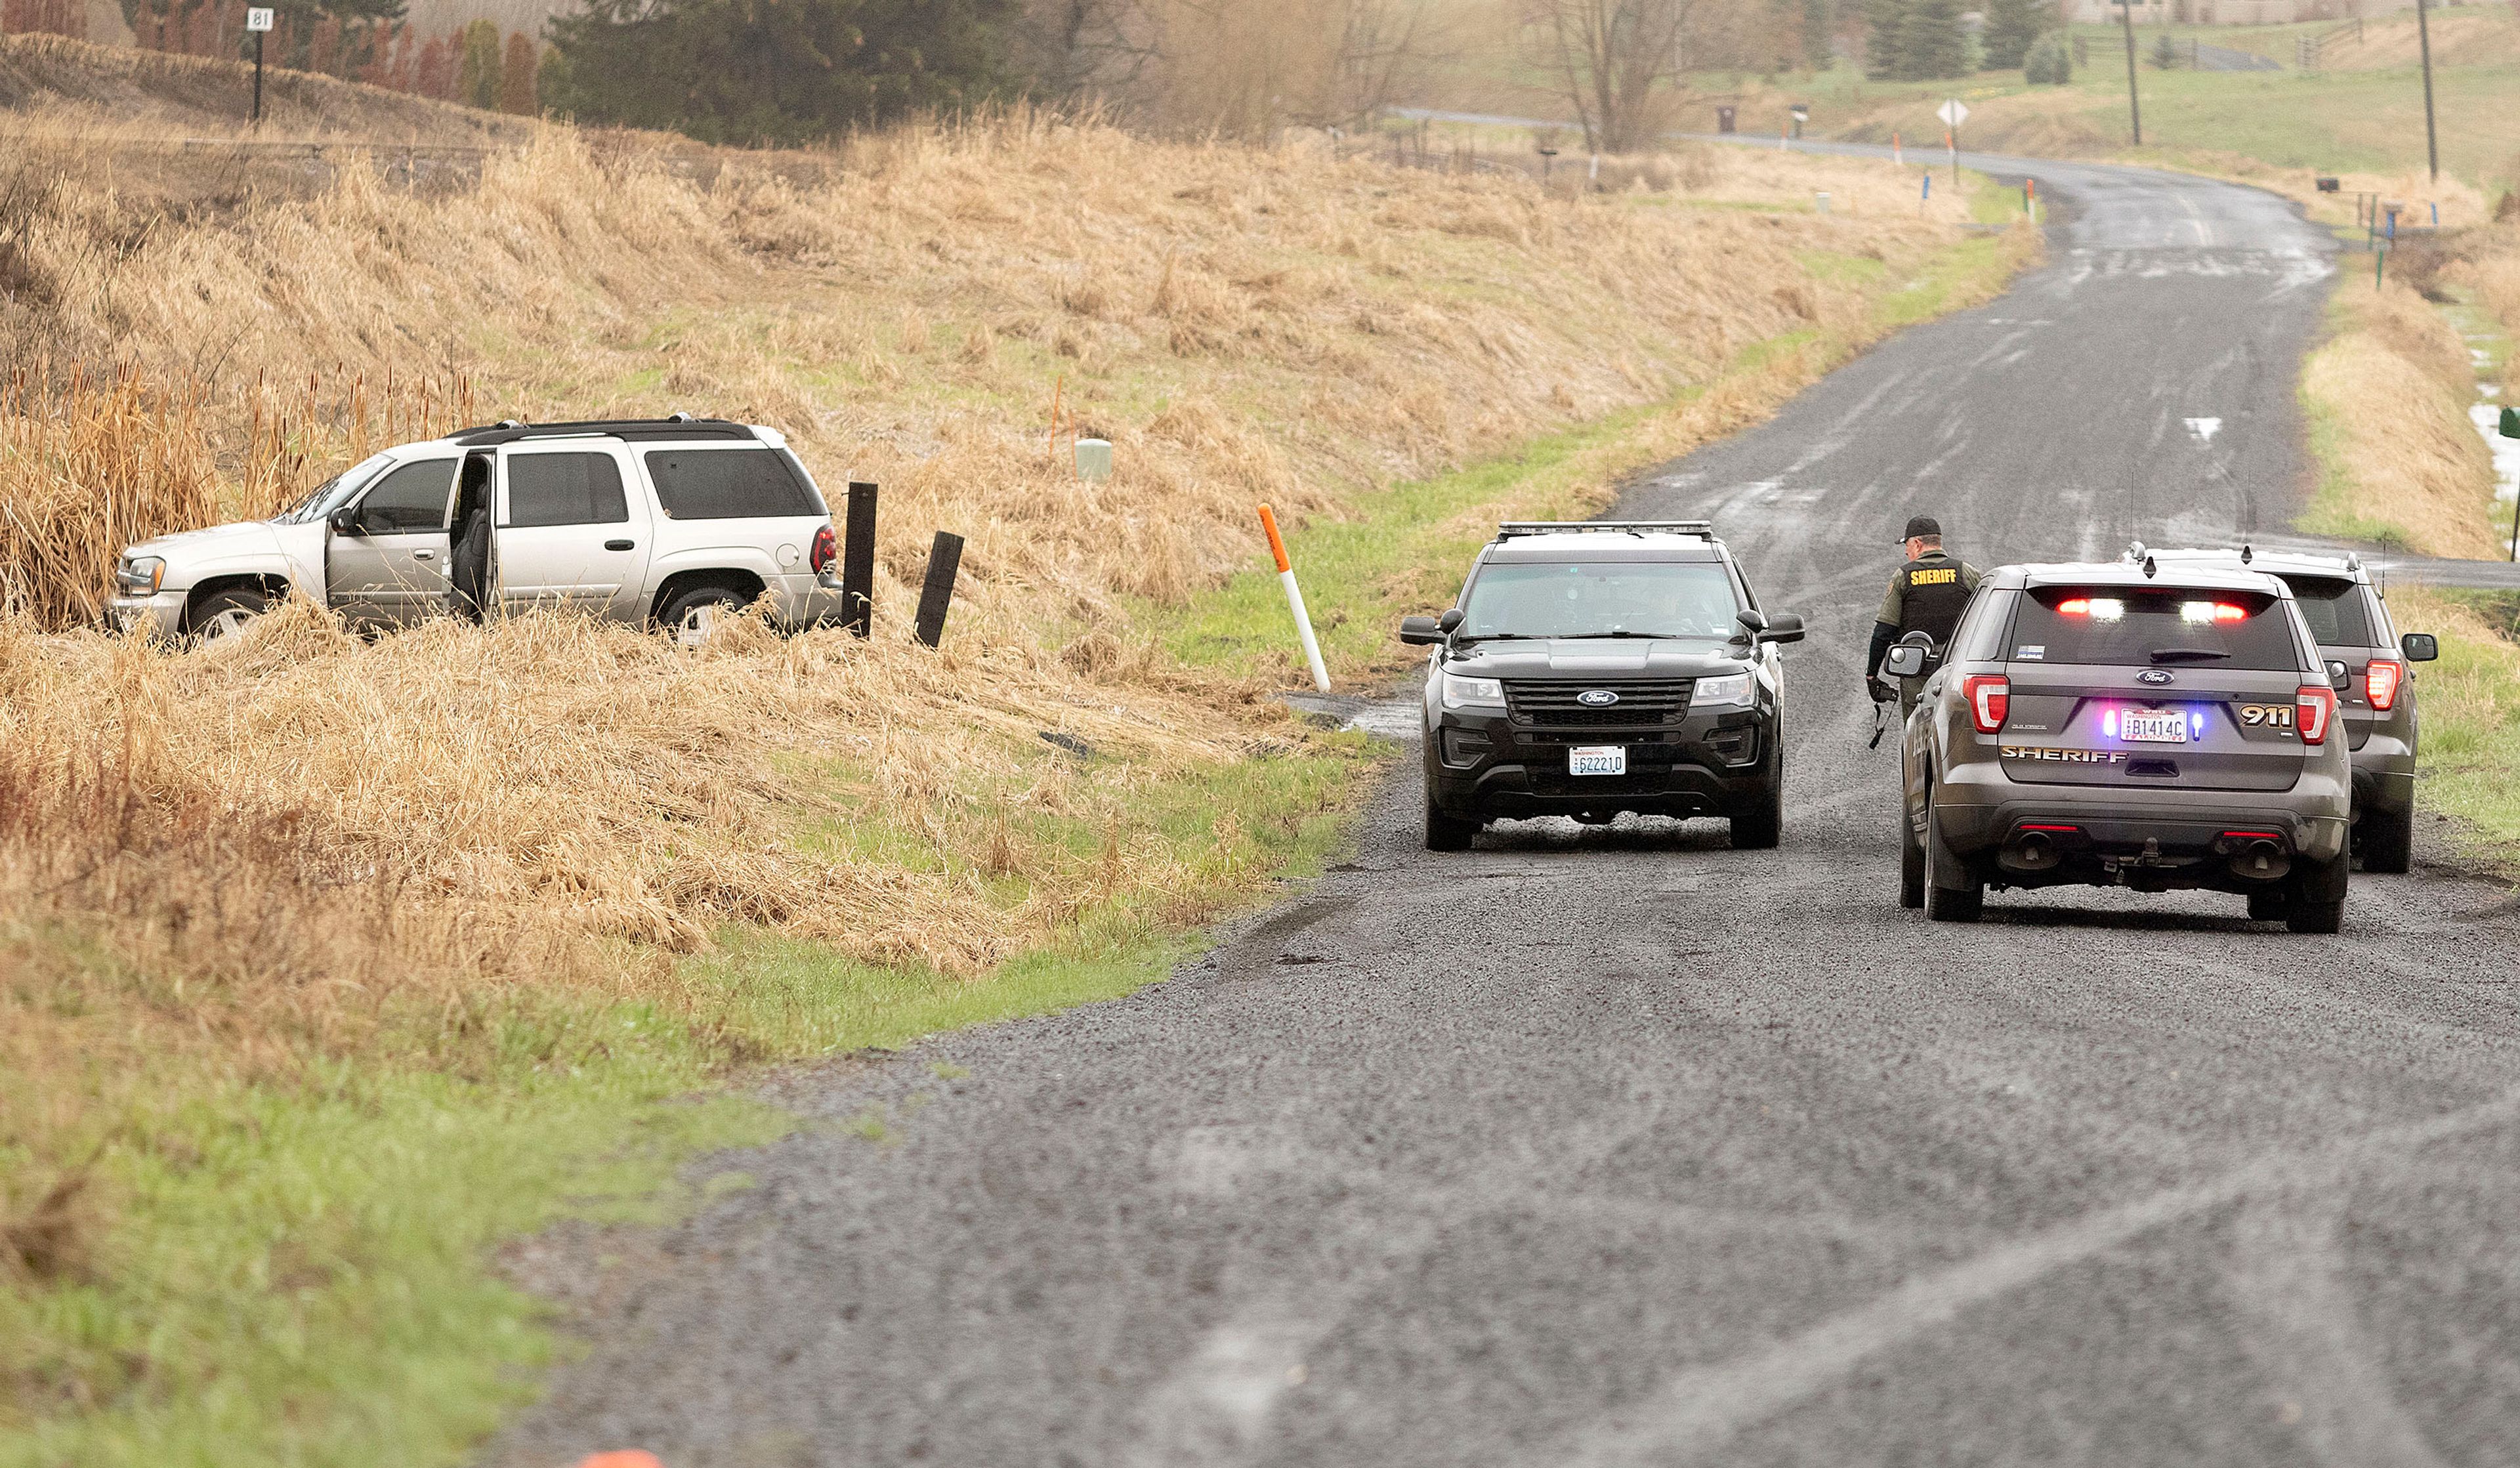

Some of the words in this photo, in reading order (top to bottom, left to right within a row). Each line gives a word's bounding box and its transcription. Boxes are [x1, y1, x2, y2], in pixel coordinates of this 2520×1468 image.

[253, 11, 268, 26] 81
[1910, 568, 1956, 585] SHERIFF
[2239, 705, 2294, 728] 911
[2133, 720, 2182, 736] B1414C
[2002, 745, 2129, 764] SHERIFF
[1580, 757, 1622, 771] 62221D
